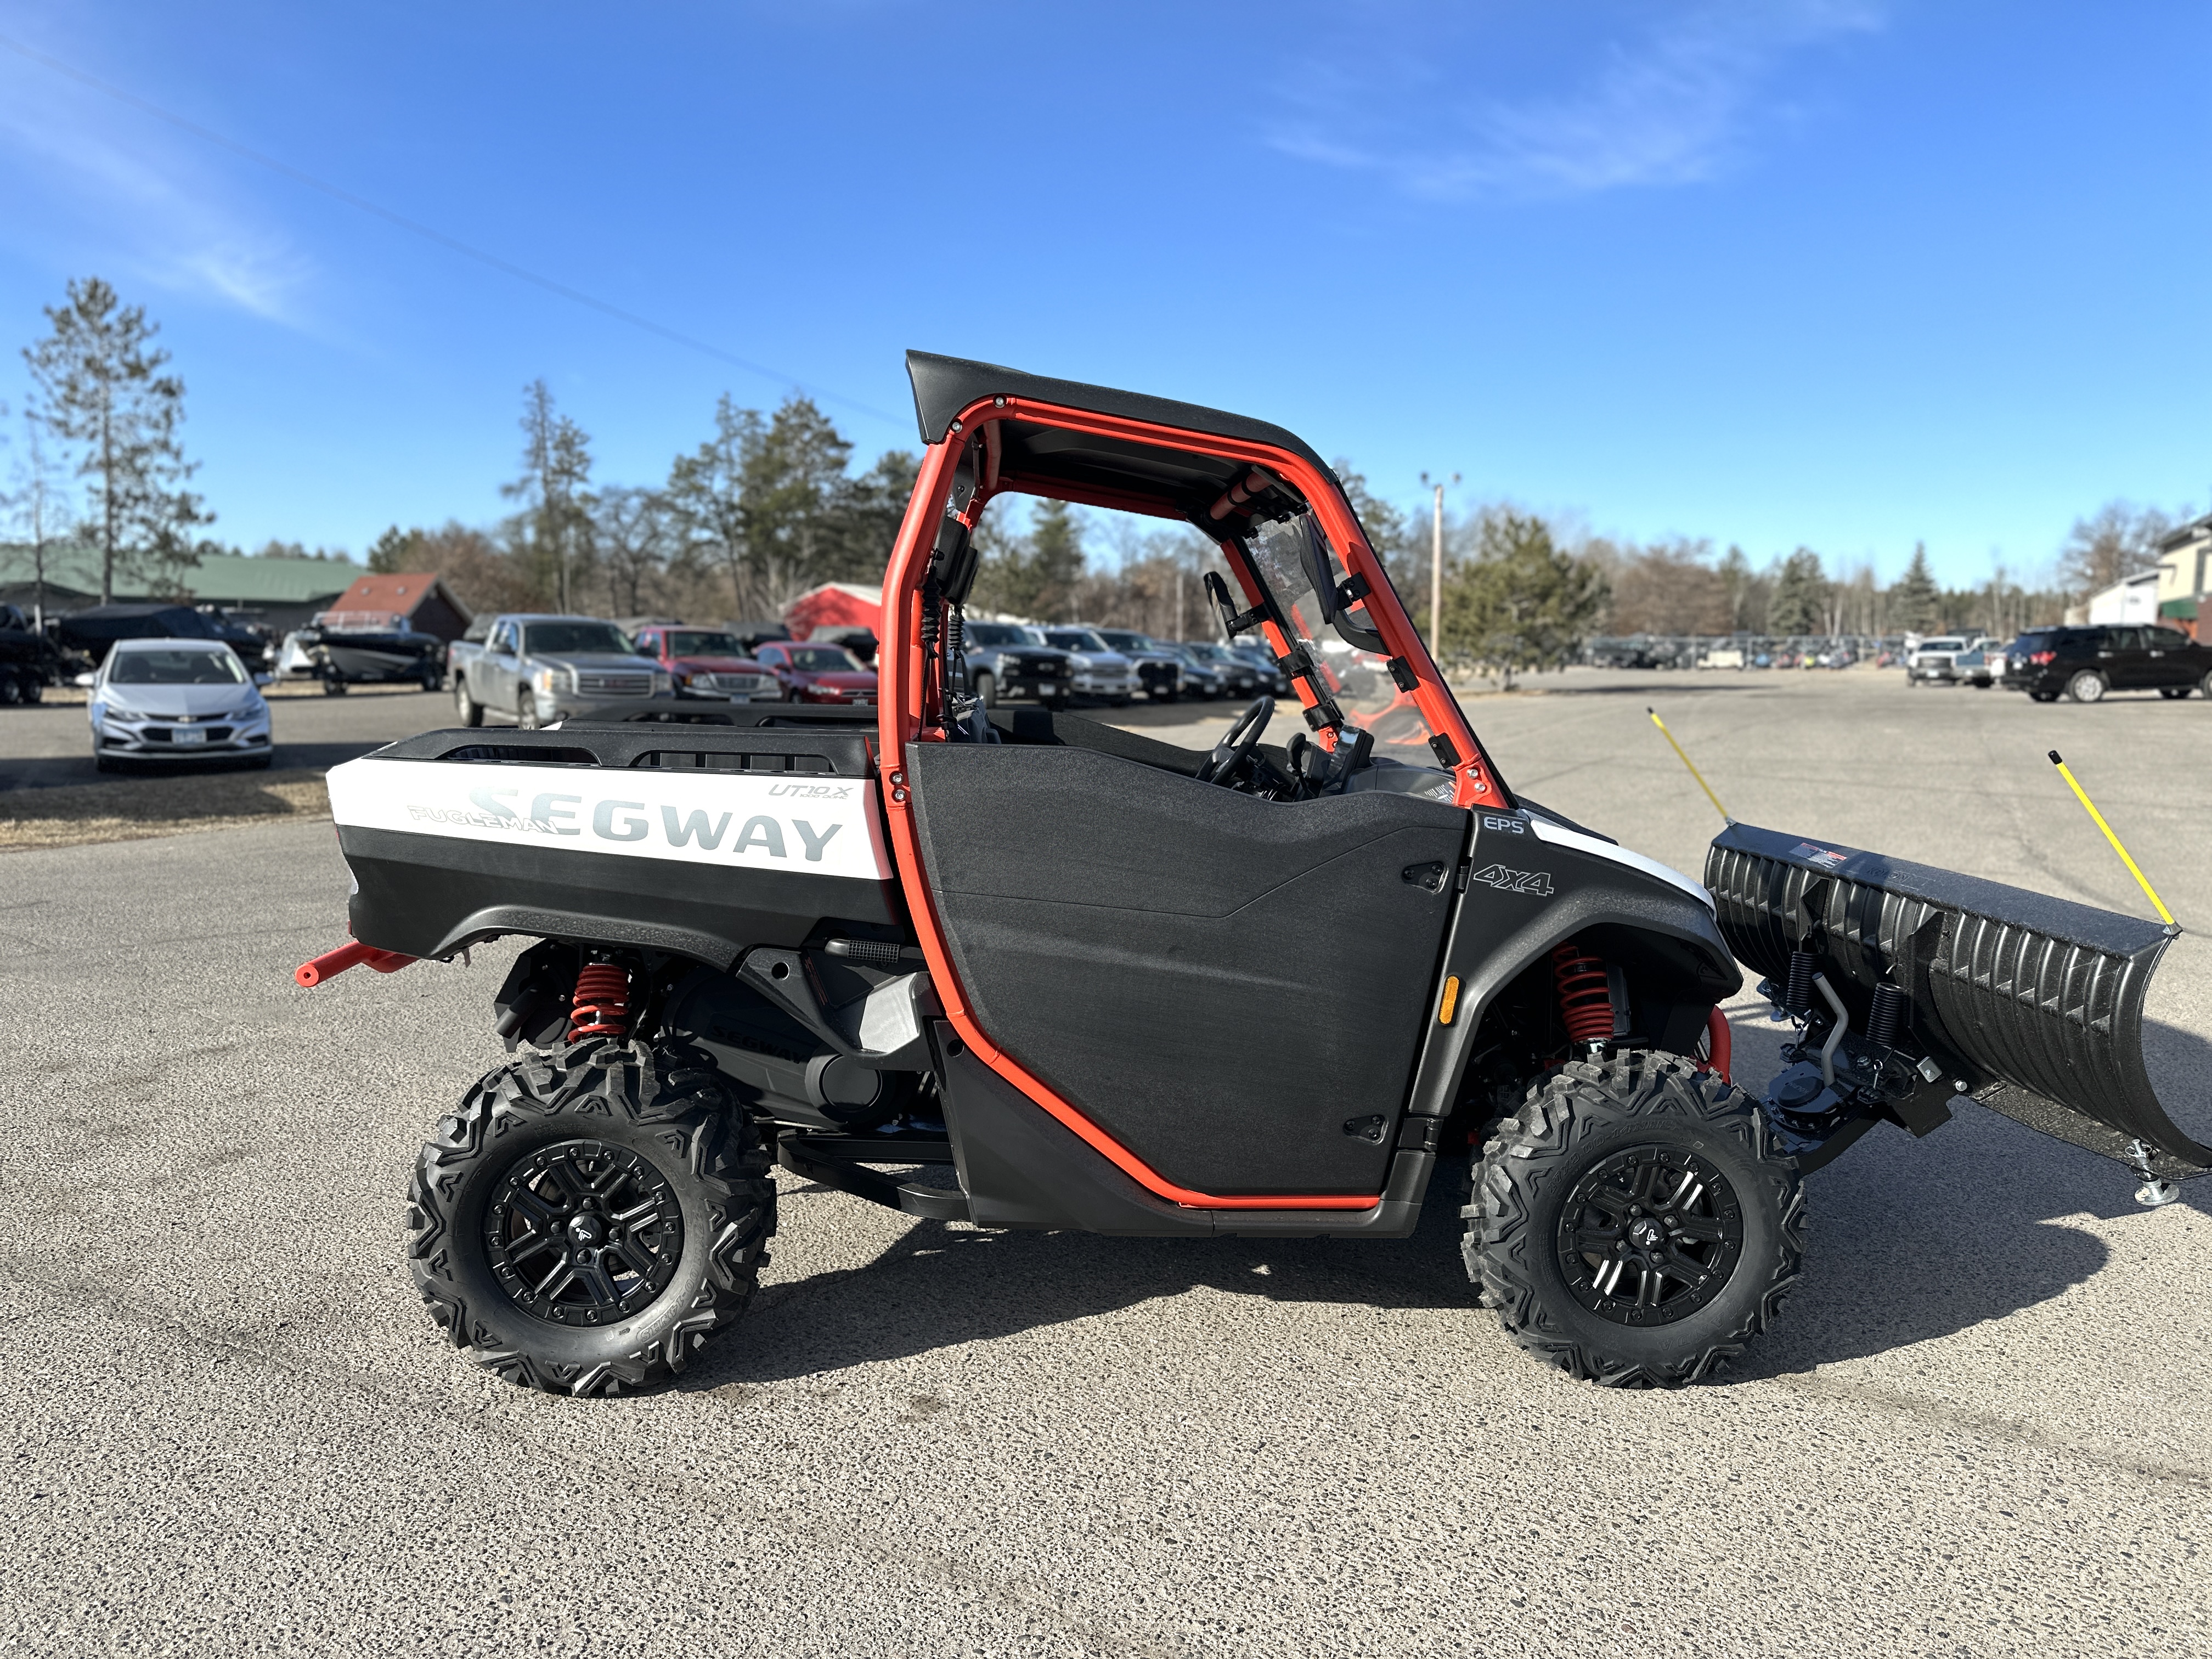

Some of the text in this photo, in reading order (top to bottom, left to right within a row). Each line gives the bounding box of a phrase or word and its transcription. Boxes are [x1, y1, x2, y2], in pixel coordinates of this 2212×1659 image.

[768, 784, 854, 797] UT10 X
[407, 805, 559, 834] FUGLEMAN
[469, 786, 843, 862] SEGWAY
[1483, 816, 1525, 834] EPS
[710, 1025, 806, 1064] SEGWAY
